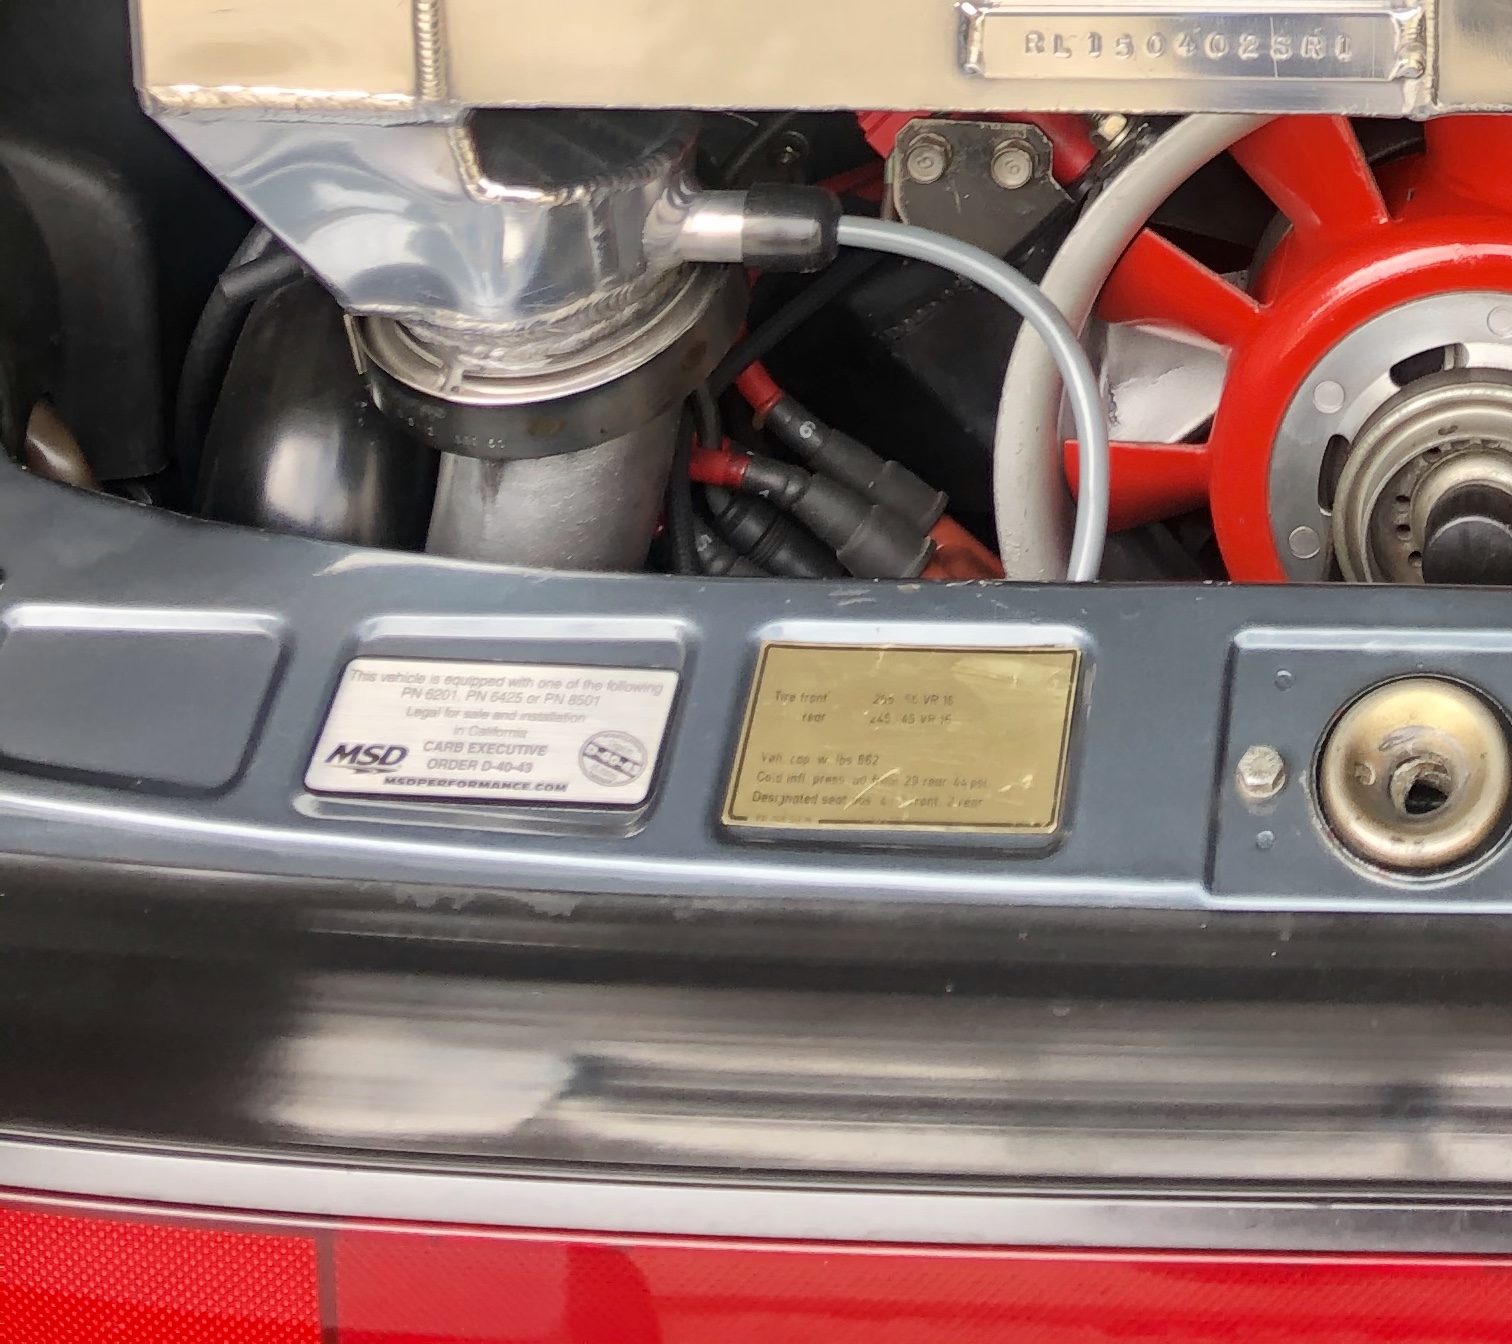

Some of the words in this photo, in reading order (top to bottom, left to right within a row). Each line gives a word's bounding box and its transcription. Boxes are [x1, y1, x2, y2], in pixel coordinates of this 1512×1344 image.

[350, 669, 376, 682] This
[381, 672, 426, 684] vehicle
[430, 674, 439, 685] is
[444, 676, 505, 688] equipped
[508, 677, 534, 689] with
[538, 679, 563, 690] one
[566, 678, 579, 690] of
[583, 680, 603, 691] the
[606, 680, 664, 696] following
[401, 687, 422, 700] PN
[465, 690, 487, 701] PN
[490, 692, 523, 704] 6425
[527, 694, 540, 704] or
[544, 694, 565, 705] PN
[568, 695, 601, 706] 8501
[406, 706, 441, 720] Legal
[444, 707, 460, 718] for
[463, 709, 490, 719] sale
[492, 710, 517, 721] and
[520, 712, 587, 723] installation
[802, 712, 826, 722] rear
[468, 726, 528, 738] California
[324, 743, 410, 768] MSD
[423, 740, 464, 753] CARB
[468, 742, 548, 756] EXECUTIVE
[427, 758, 478, 771] ORDER
[383, 776, 568, 792] MSDPERFORMANCE.COM
